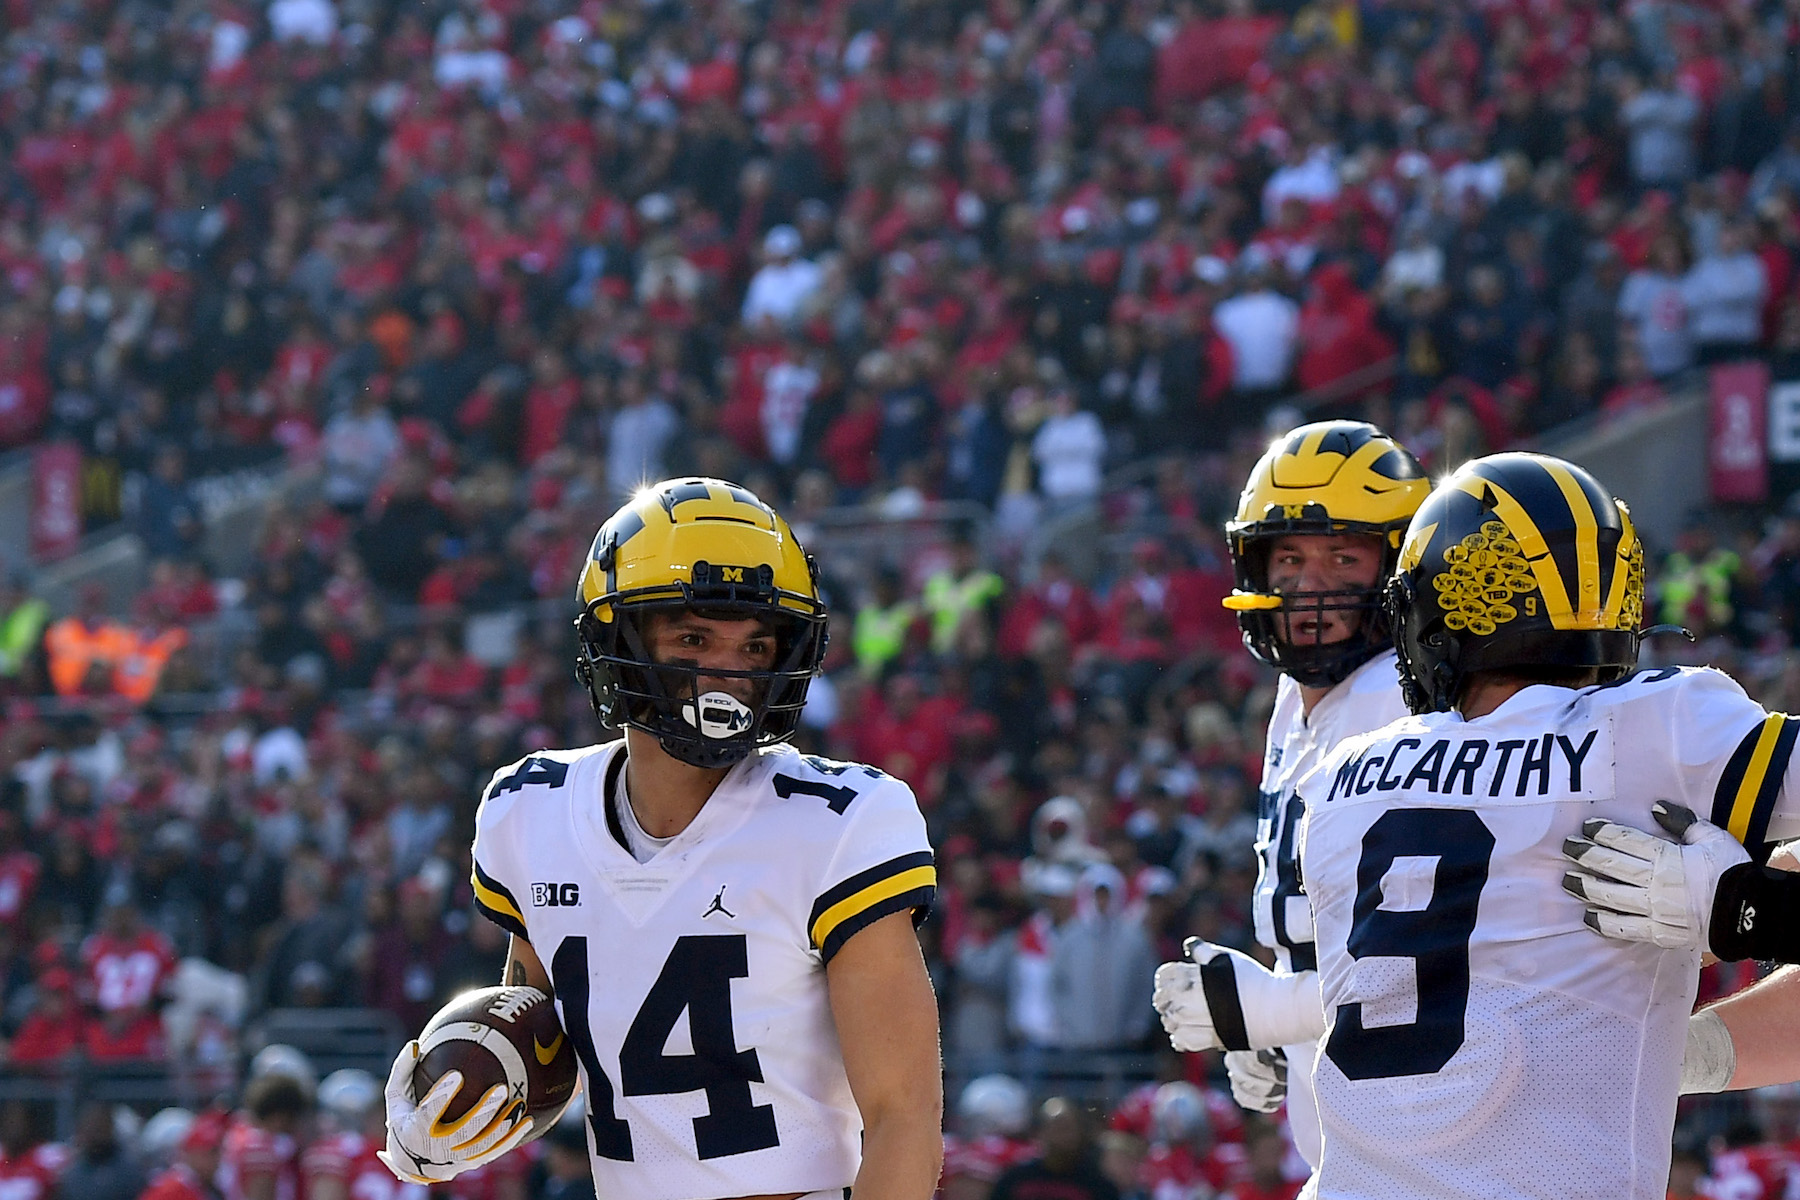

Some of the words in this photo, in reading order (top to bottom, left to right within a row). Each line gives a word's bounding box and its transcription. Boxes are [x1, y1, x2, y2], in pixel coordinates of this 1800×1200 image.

[722, 567, 744, 583] M
[1486, 591, 1508, 601] TED
[1524, 597, 1537, 617] 9
[1326, 729, 1599, 802] McCARTHY
[1324, 806, 1497, 1082] 9
[551, 934, 781, 1161] 14
